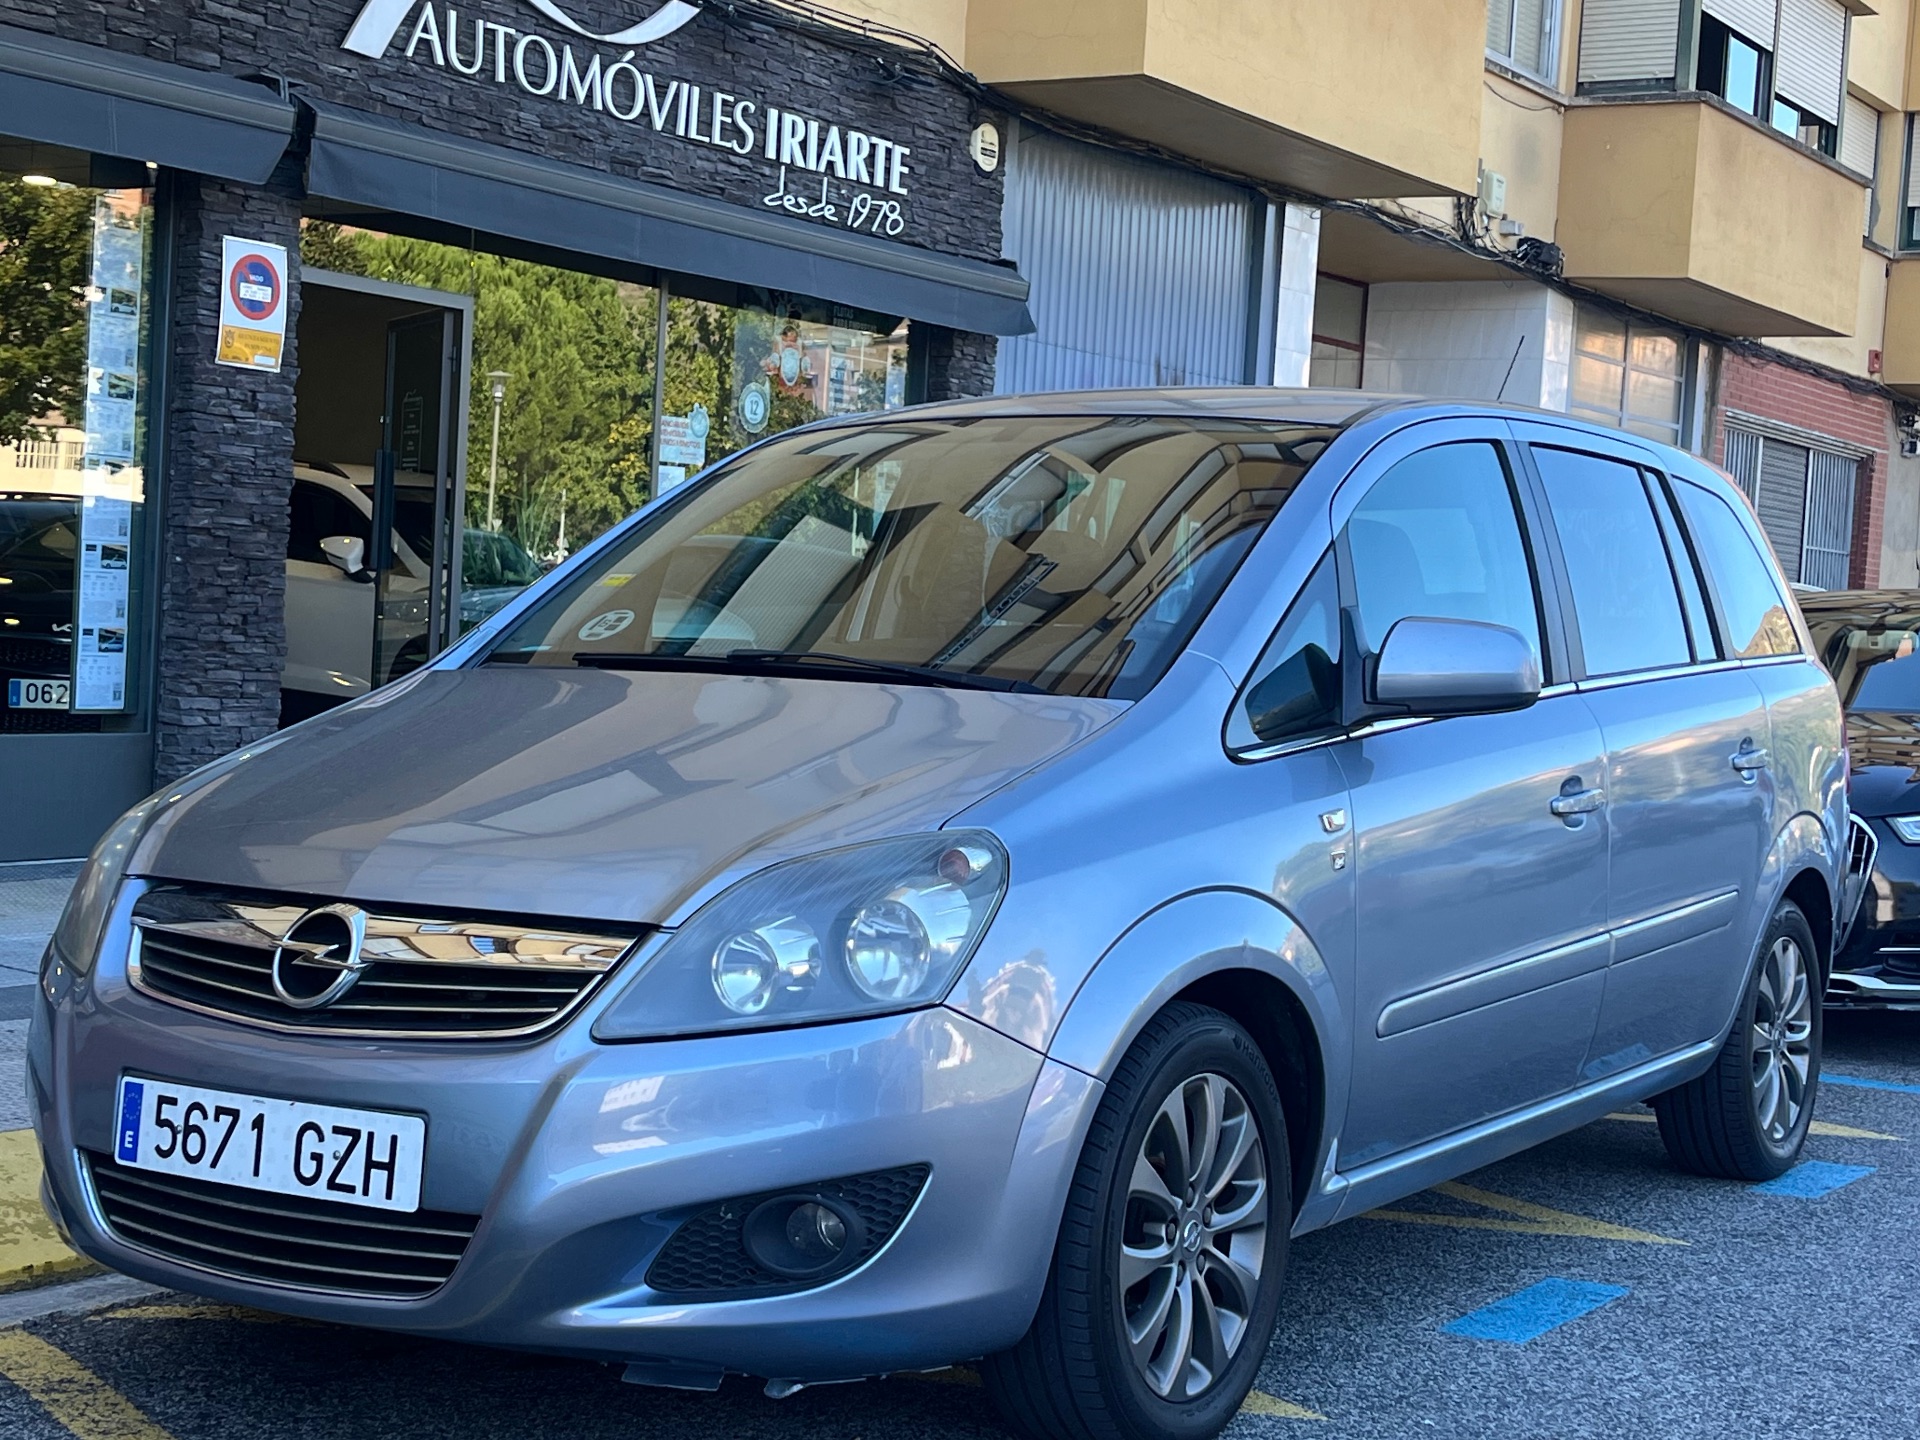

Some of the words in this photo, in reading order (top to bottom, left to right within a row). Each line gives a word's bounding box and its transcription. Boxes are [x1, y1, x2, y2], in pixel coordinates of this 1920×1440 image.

[405, 1, 755, 154] AUTOMÓVILES
[764, 108, 911, 195] IRIARTE
[763, 165, 839, 221] desde
[847, 193, 905, 235] 1978
[750, 399, 759, 415] 12
[26, 682, 68, 704] 062
[1241, 1040, 1280, 1106] Hankook
[124, 1131, 133, 1148] E
[154, 1094, 265, 1178] 5671
[293, 1121, 398, 1200] GZH
